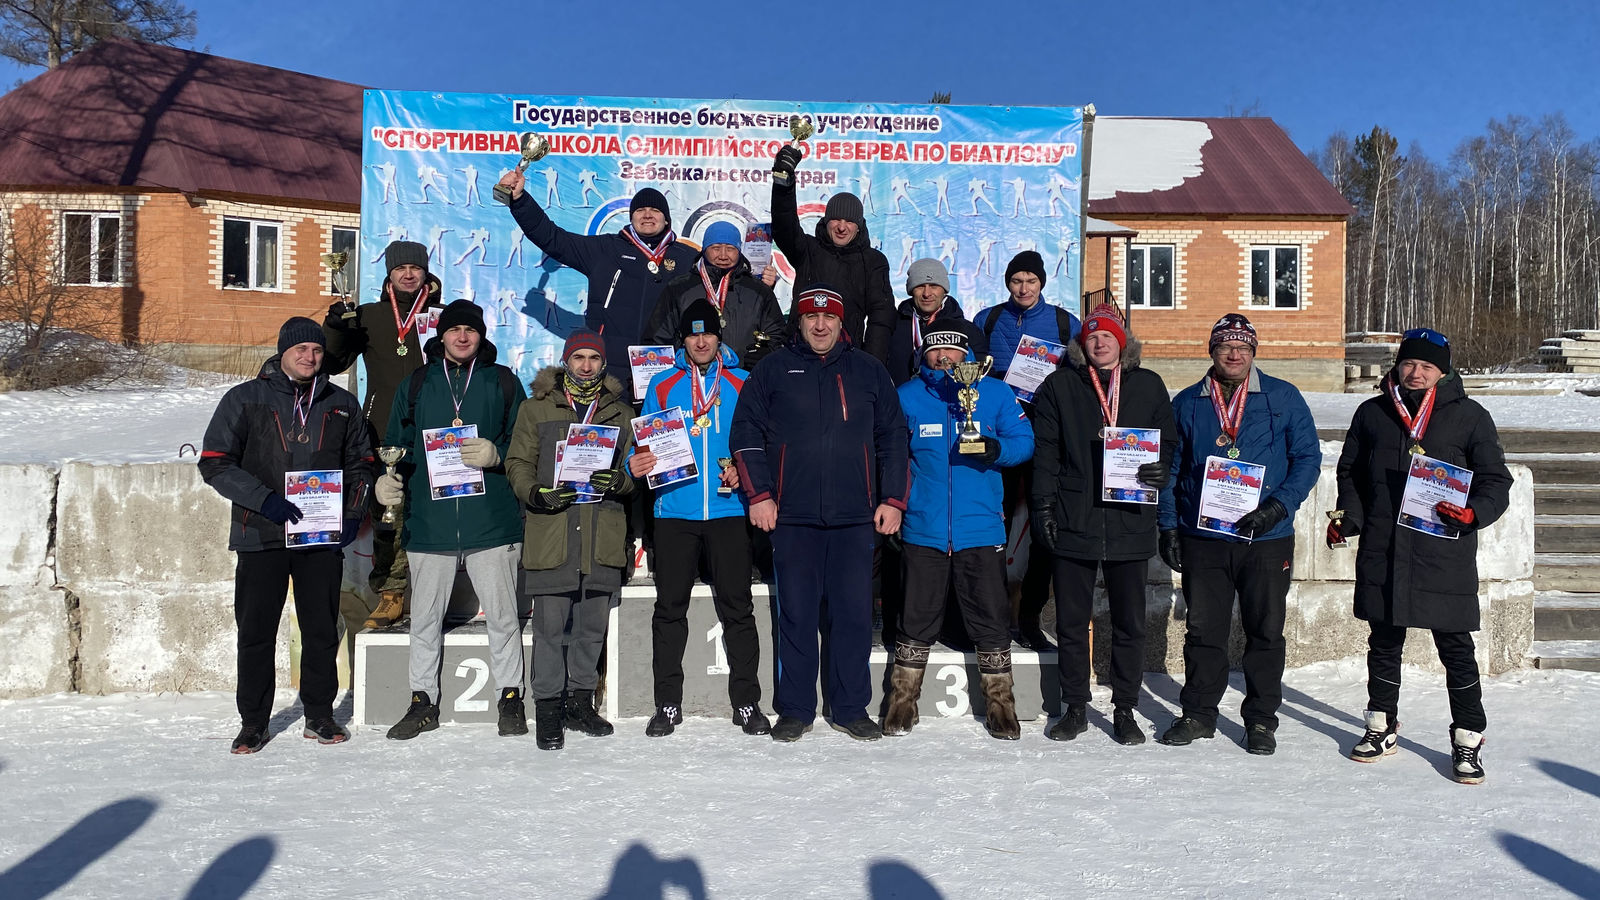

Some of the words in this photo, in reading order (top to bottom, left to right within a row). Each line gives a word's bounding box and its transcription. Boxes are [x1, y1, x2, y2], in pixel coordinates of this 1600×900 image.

[515, 103, 692, 127] Государственное
[697, 107, 812, 129] бюджетне
[817, 114, 940, 133] учреждение
[374, 129, 520, 151] "СПОРТИВНА
[626, 135, 810, 159] ОЛИМПИЙСКОО
[816, 142, 909, 161] РЕЗЕРВА
[914, 143, 945, 161] ПО
[950, 144, 1075, 163] БИАТЛОНУ"
[620, 161, 773, 183] Забайкальског
[707, 621, 730, 675] 1
[454, 658, 489, 712] 2
[935, 665, 969, 717] 3
